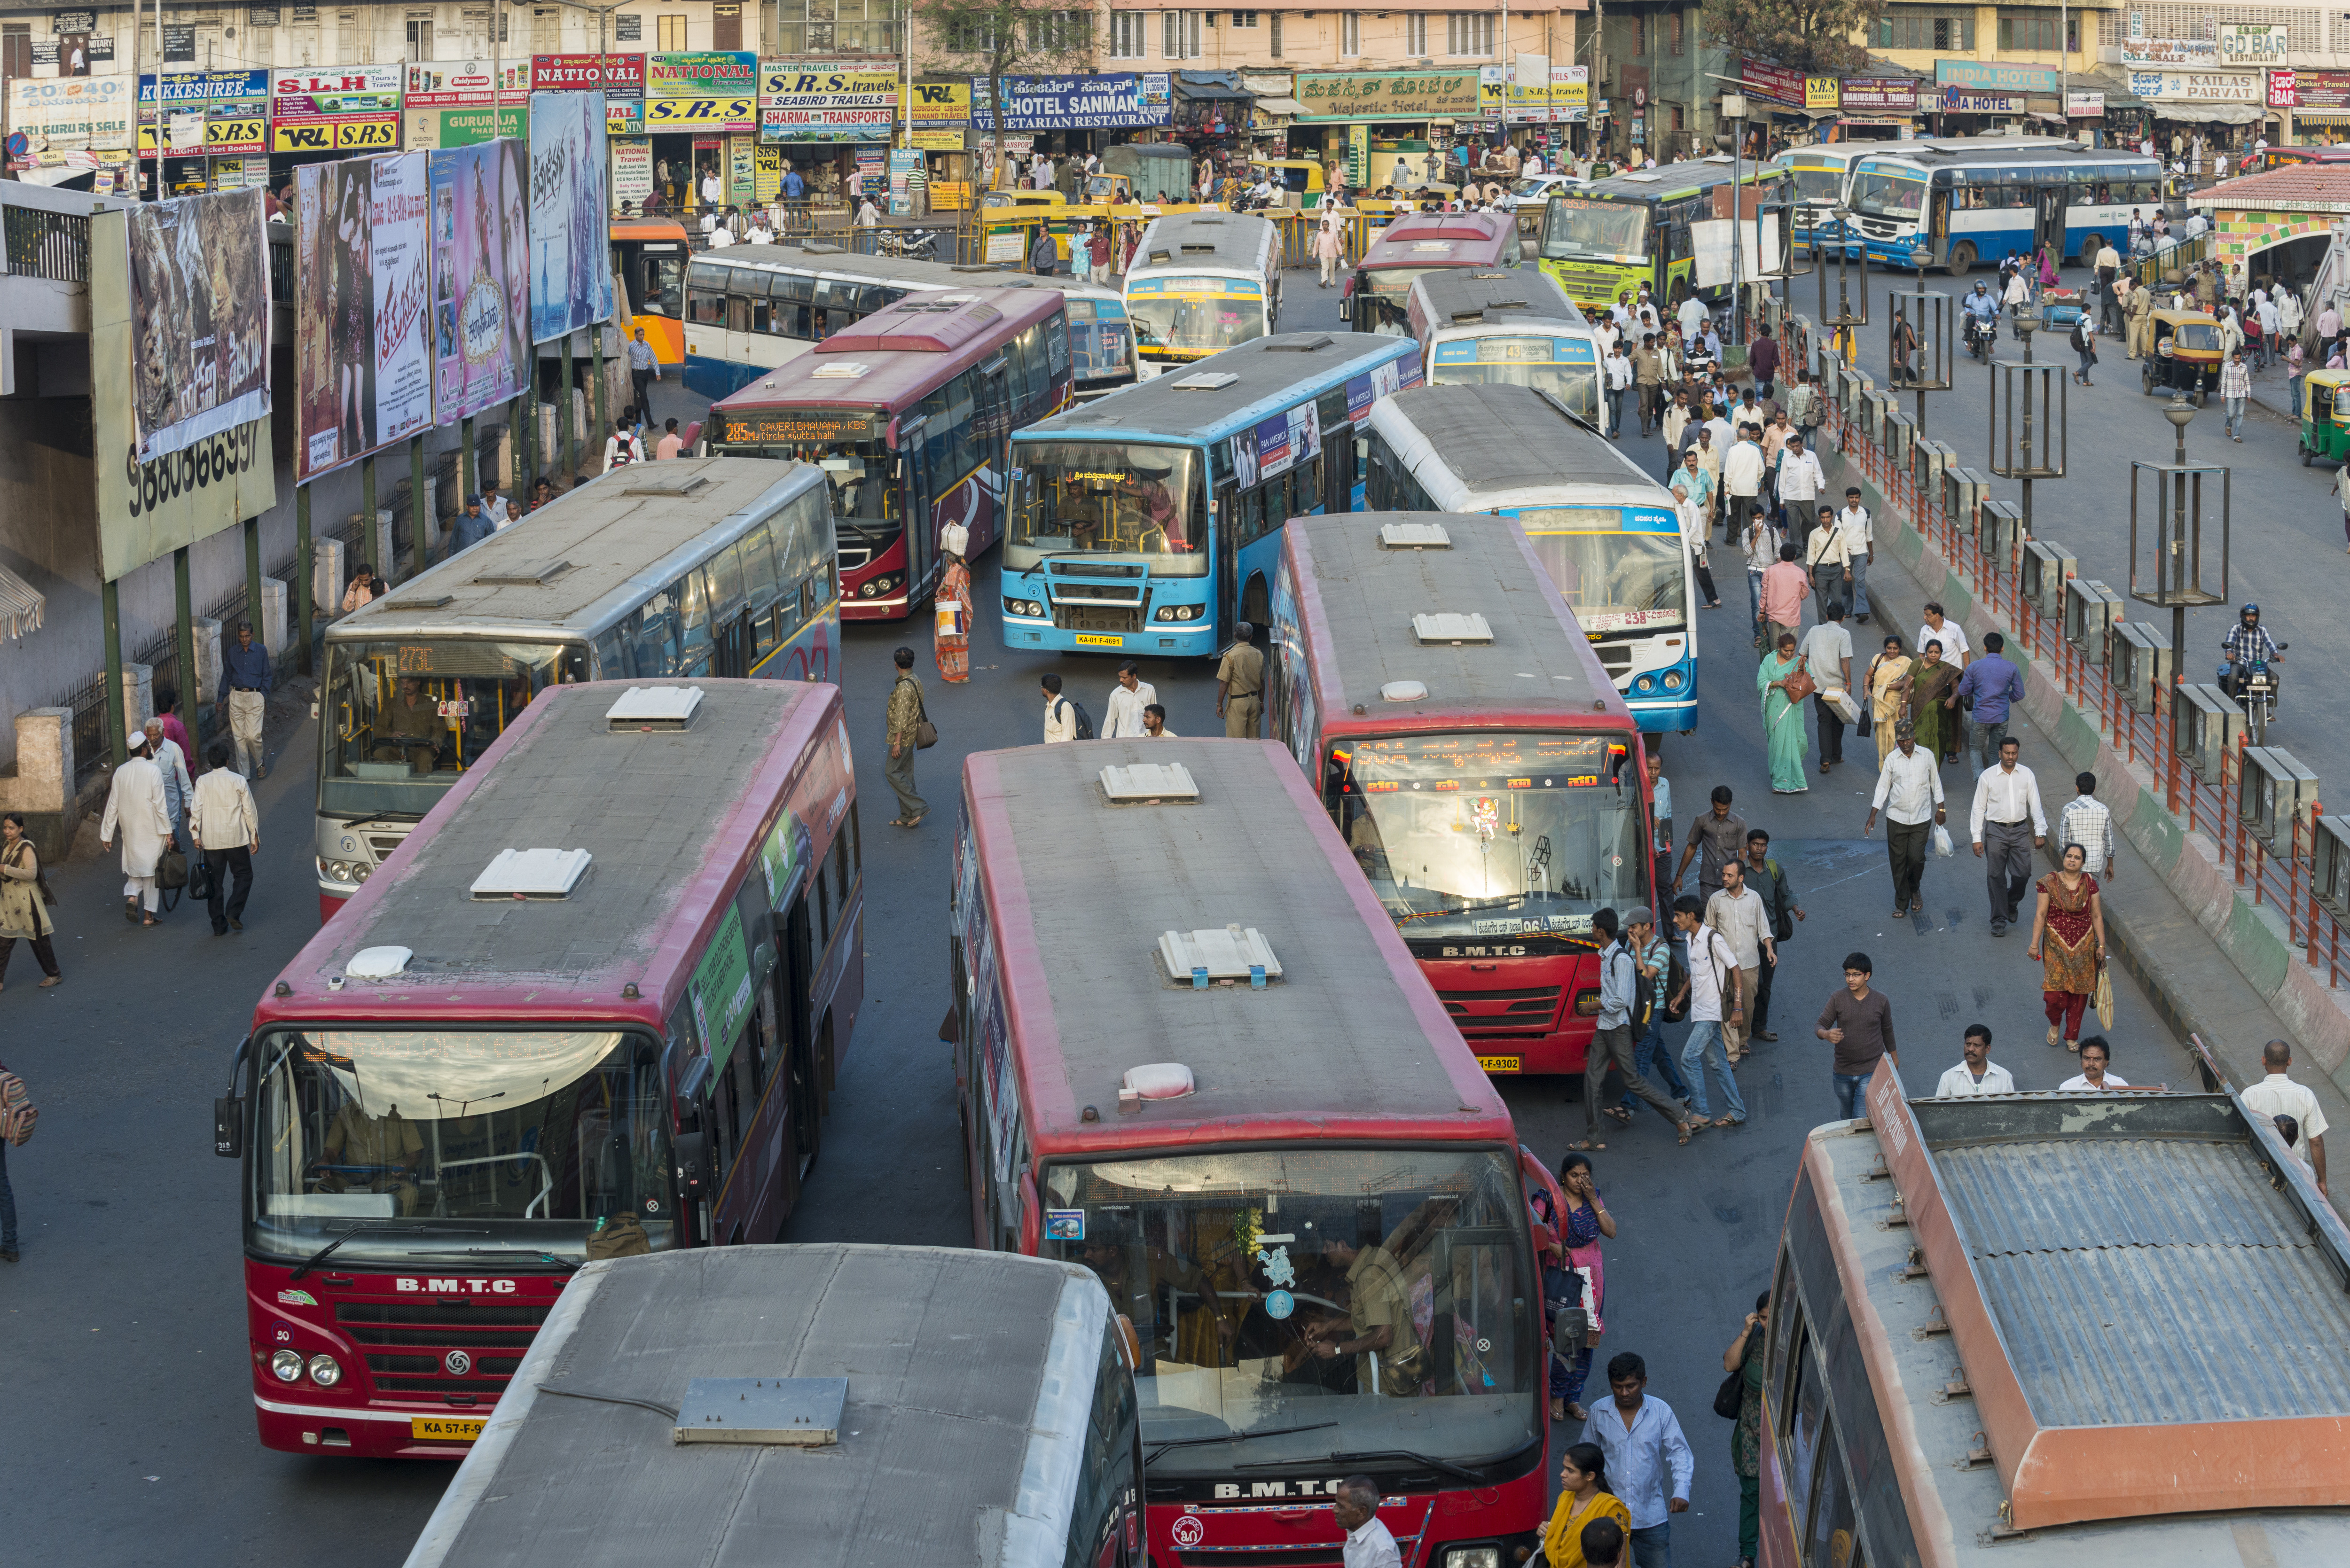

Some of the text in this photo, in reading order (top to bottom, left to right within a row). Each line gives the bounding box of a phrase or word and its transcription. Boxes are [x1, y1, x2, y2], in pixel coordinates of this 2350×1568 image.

[2223, 35, 2286, 54] GD BAR
[2229, 54, 2278, 62] RESTAURANT
[537, 67, 639, 81] NATIONAL
[651, 65, 753, 78] NATIONAL
[1947, 68, 2050, 85] INDIA HOTEL
[277, 76, 367, 94] S.L.H
[453, 77, 488, 86] Baidyanath
[766, 74, 894, 92] S.R.S. travels
[1743, 69, 1802, 91] MANJUSHREE TRAVELS
[1809, 78, 1836, 94] S.R.S
[2189, 75, 2251, 86] KAILAS
[2275, 73, 2295, 88] ಬಾರ್
[141, 81, 244, 101] KUKKESHREE
[458, 91, 529, 101] GURURAJA HARMACY
[1843, 93, 1914, 102] MANJUSHREE TRAVELS
[2187, 87, 2253, 98] PARVAT
[2274, 90, 2294, 105] BAR
[775, 95, 884, 105] SEABIRD TRAVELS
[1010, 95, 1138, 115] HOTEL SANMAN
[1973, 97, 2012, 110] HOTEL
[649, 100, 752, 118] S.R.S
[1150, 105, 1170, 114] RESTAURANT
[1329, 100, 1428, 117] Majestic Hotel
[2069, 106, 2102, 115] INDIA LODGE
[766, 111, 810, 124] SHARMA
[822, 111, 891, 123] TRANSPORTS
[977, 114, 1166, 129] VEETARIAN RESTAURANT
[17, 121, 125, 135] SRI GURU SALE
[626, 121, 642, 132] NTN
[279, 124, 394, 148] VRL S.R.S
[757, 147, 777, 157] SRS
[757, 160, 779, 171] VRL
[1507, 345, 1520, 357] 43
[1355, 390, 1371, 405] AMERICA
[760, 422, 795, 431] CAVERI
[761, 431, 785, 440] Circle
[1270, 431, 1287, 446] AMERICA
[1074, 472, 1083, 480] ಶ್ರೀ
[400, 647, 433, 671] 273C
[1367, 774, 1598, 793] ಬೆಂ ಮ ಸಾ ಸಂ
[1443, 945, 1526, 957] B.M.T.C
[1876, 1075, 1909, 1156] Air Suspension
[397, 1278, 516, 1293] B.M.T.C
[1215, 1479, 1344, 1498] B.M.T.C
